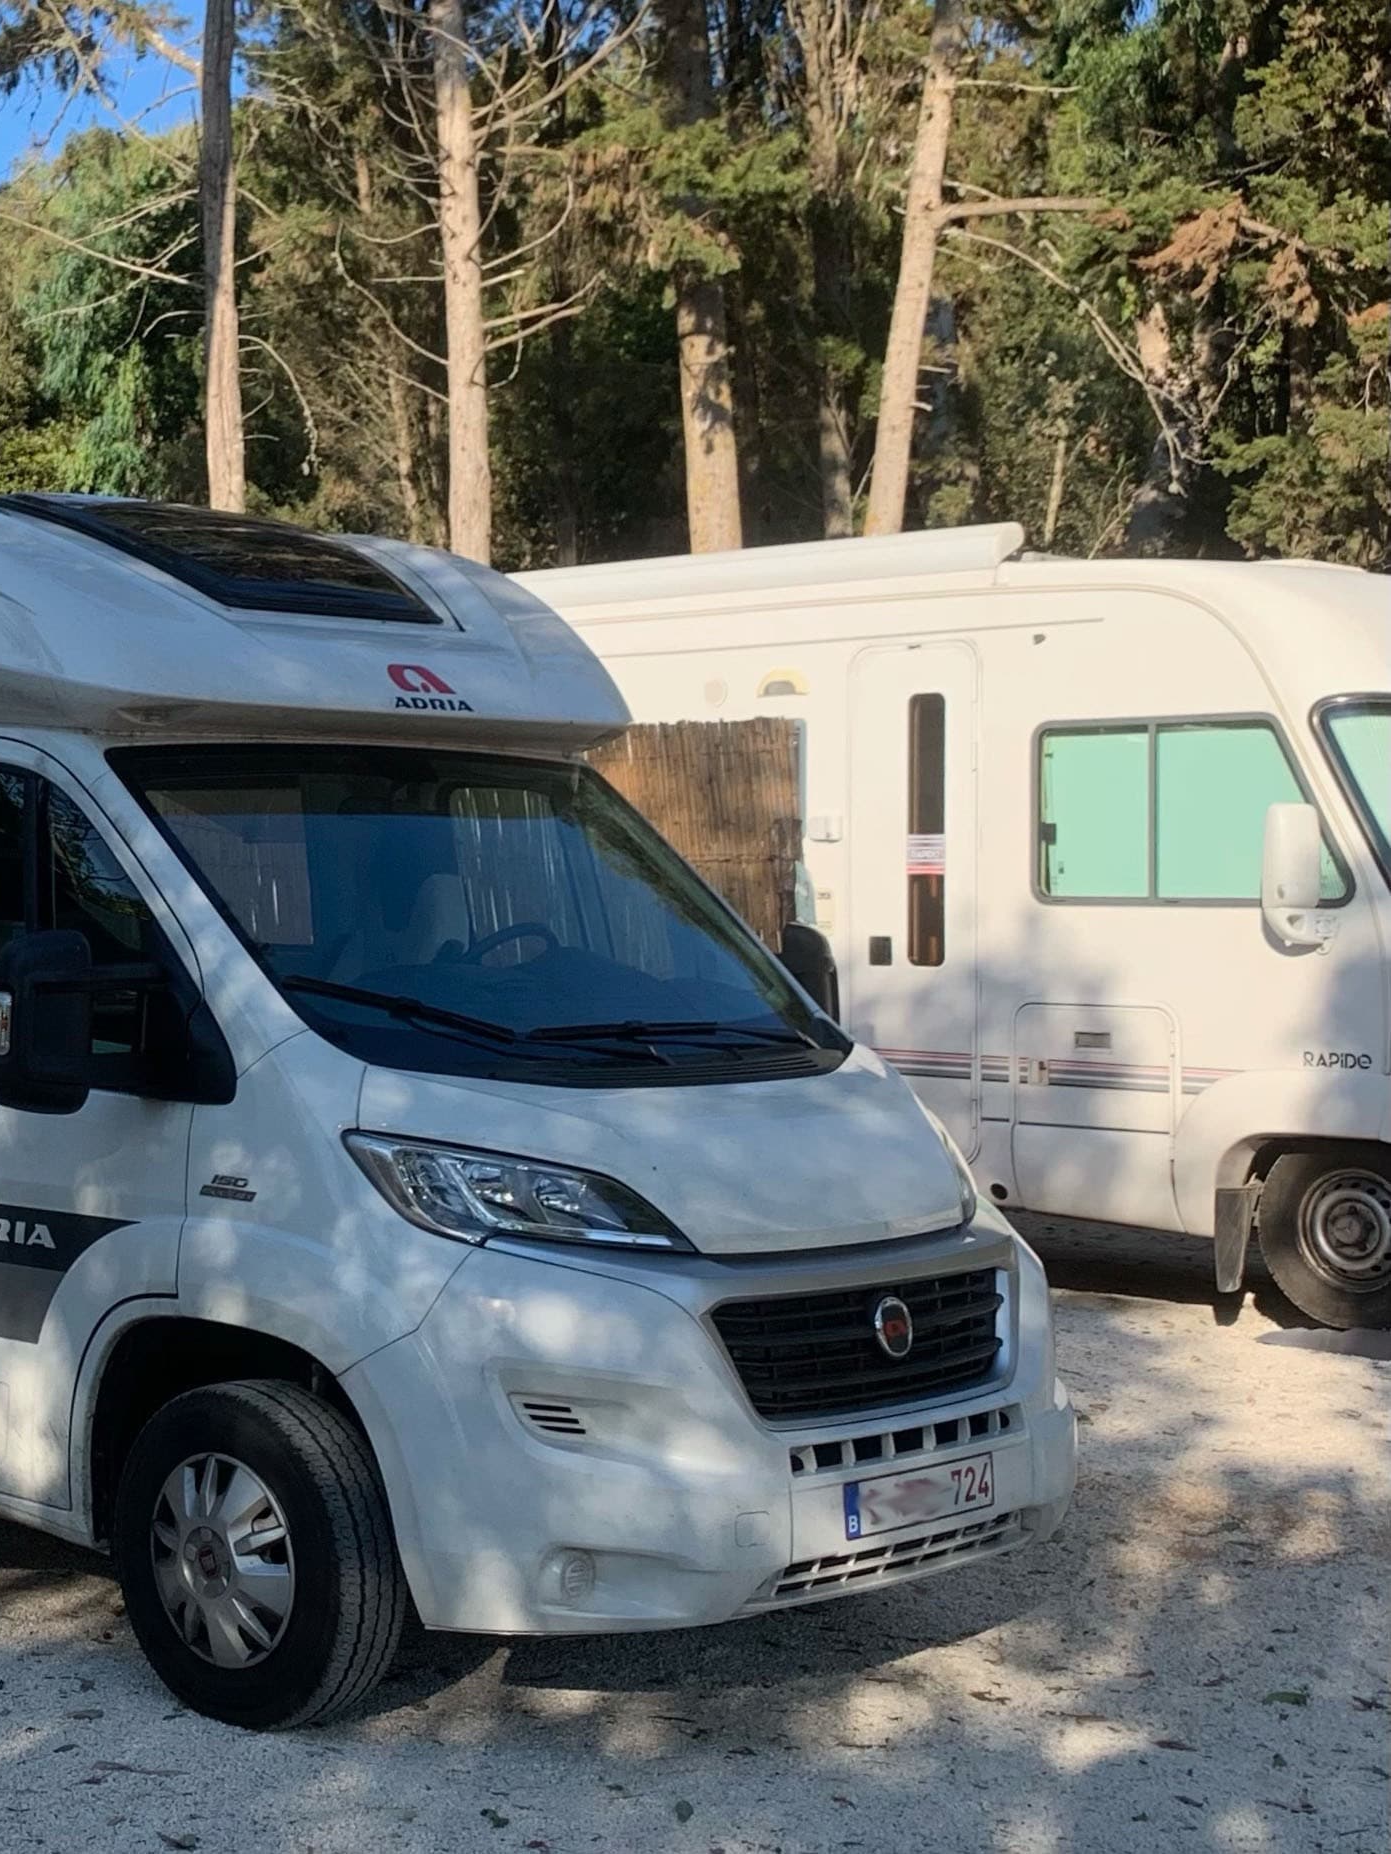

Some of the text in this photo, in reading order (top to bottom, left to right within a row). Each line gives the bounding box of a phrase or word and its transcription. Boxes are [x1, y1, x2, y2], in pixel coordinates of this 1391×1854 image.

[395, 697, 474, 712] ADRIA
[1303, 1051, 1373, 1069] RAPIDO
[848, 1515, 859, 1533] B
